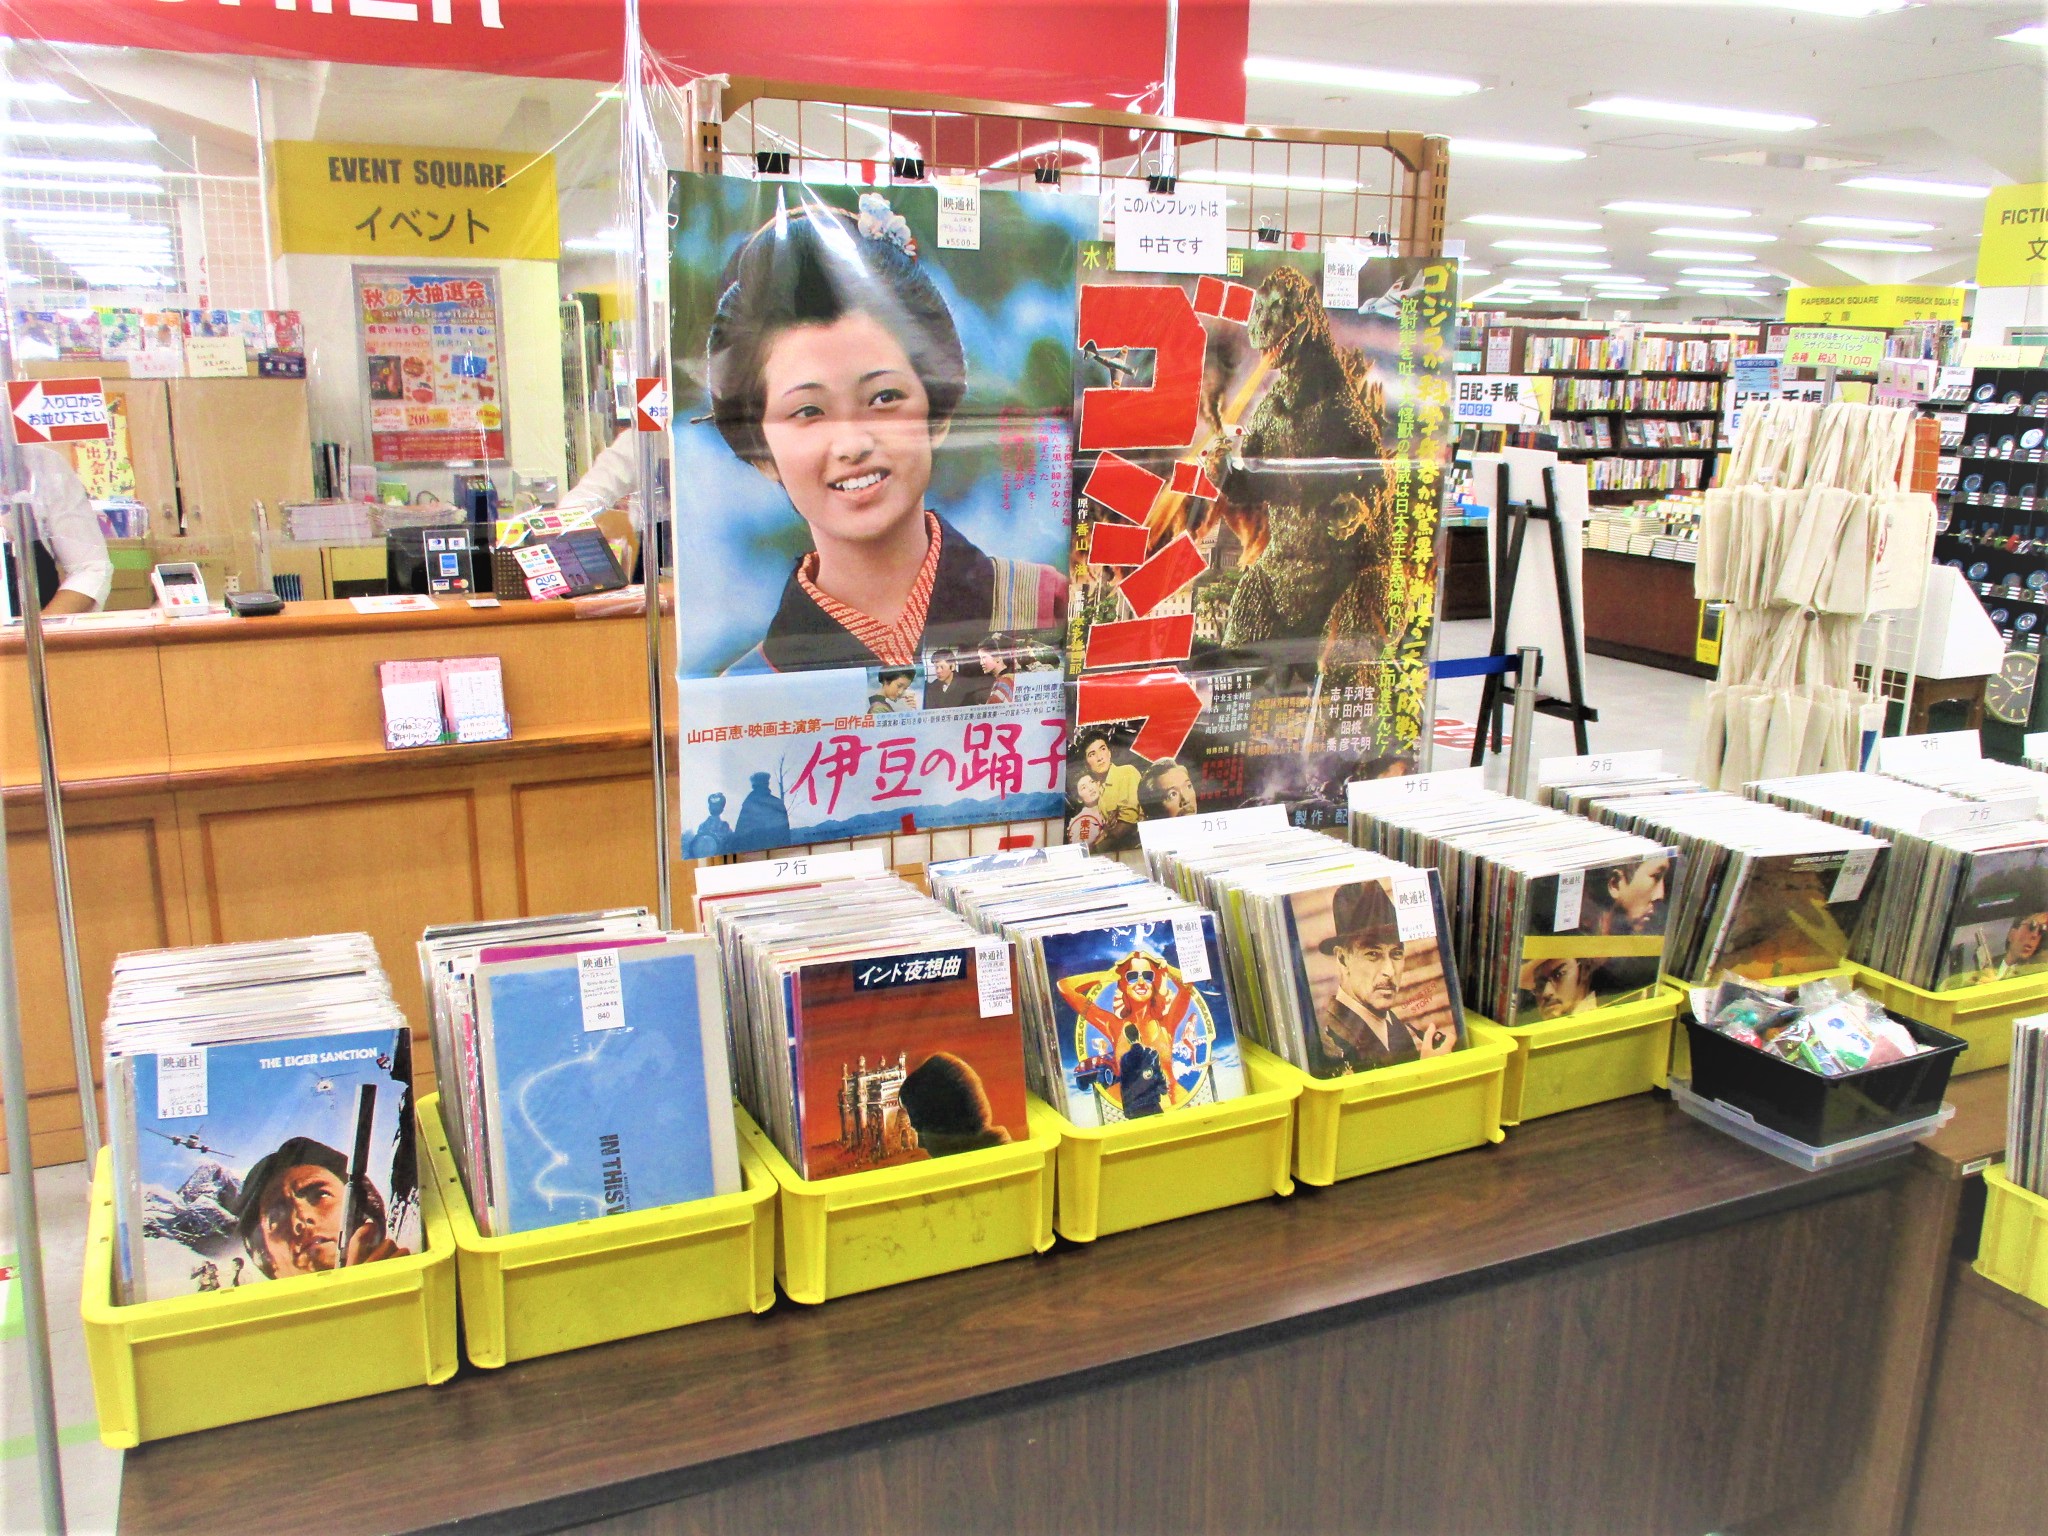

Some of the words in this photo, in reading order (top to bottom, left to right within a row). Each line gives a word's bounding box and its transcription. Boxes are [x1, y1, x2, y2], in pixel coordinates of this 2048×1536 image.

[328, 157, 402, 185] EVENT
[413, 159, 507, 189] SQUARE
[1123, 197, 1219, 217] このパンフレットは
[355, 206, 490, 244] イベント
[2001, 207, 2048, 226] FICTI
[1139, 236, 1204, 255] 中古です
[362, 280, 486, 309] 秋の大抽選会
[1801, 297, 1845, 305] PAPERBACK
[1847, 296, 1879, 304] SQUARE
[1459, 382, 1519, 402] 日記・手帳
[42, 395, 103, 410] 入り口から
[1459, 404, 1492, 417] 2022
[28, 411, 106, 426] お並び下さい
[535, 574, 557, 586] QUO
[686, 714, 877, 745] 山口百恵・映画主演第一回作品
[1921, 737, 1939, 750] マ行
[790, 718, 1067, 815] 伊豆の踊子
[1405, 778, 1430, 794] サ行
[1968, 806, 1991, 821] ナ行
[774, 859, 808, 877] ア行
[1399, 889, 1428, 905] 映通社
[583, 955, 614, 969] 映通社
[858, 954, 962, 986] インド夜想曲
[597, 1012, 610, 1020] 840
[162, 1055, 199, 1069] 映通社
[259, 1057, 282, 1069] THE
[284, 1053, 318, 1067] EIGER
[320, 1047, 377, 1063] SANCTION
[162, 1103, 202, 1118] ¥1950
[599, 1133, 621, 1156] IN
[602, 1157, 625, 1204] THIS
